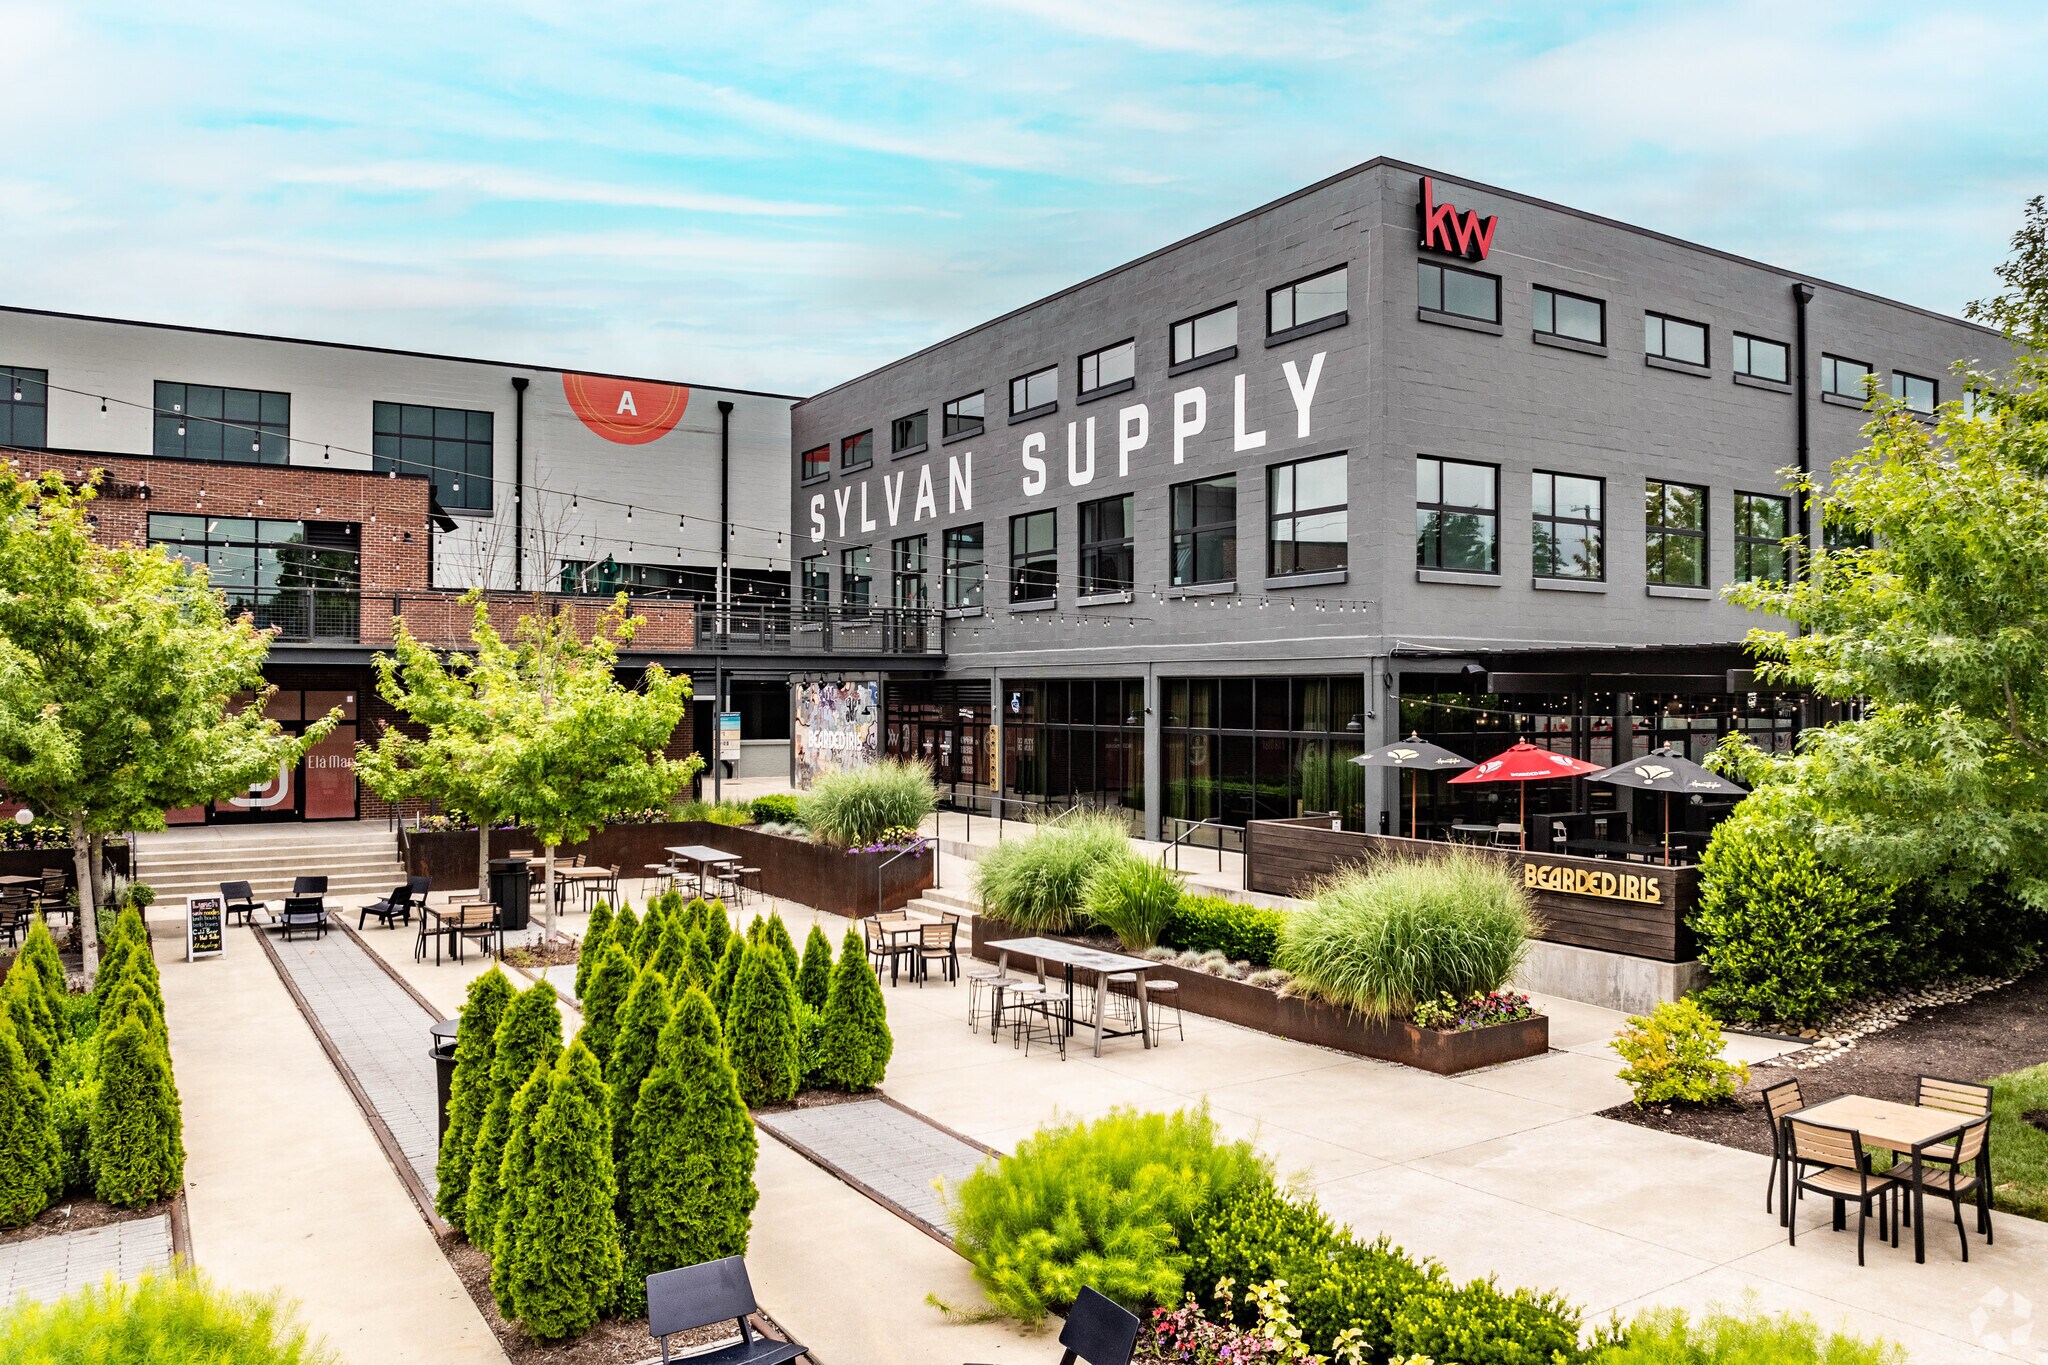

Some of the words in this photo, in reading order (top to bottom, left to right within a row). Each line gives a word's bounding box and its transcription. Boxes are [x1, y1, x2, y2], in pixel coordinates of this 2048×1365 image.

[616, 391, 638, 416] A
[810, 452, 972, 543] SYLVAN
[1021, 352, 1327, 497] SUPPLY
[808, 730, 845, 750] BEARDED
[846, 731, 863, 751] IRIS
[1525, 863, 1617, 896] BEARDED
[1620, 874, 1661, 901] IRIS
